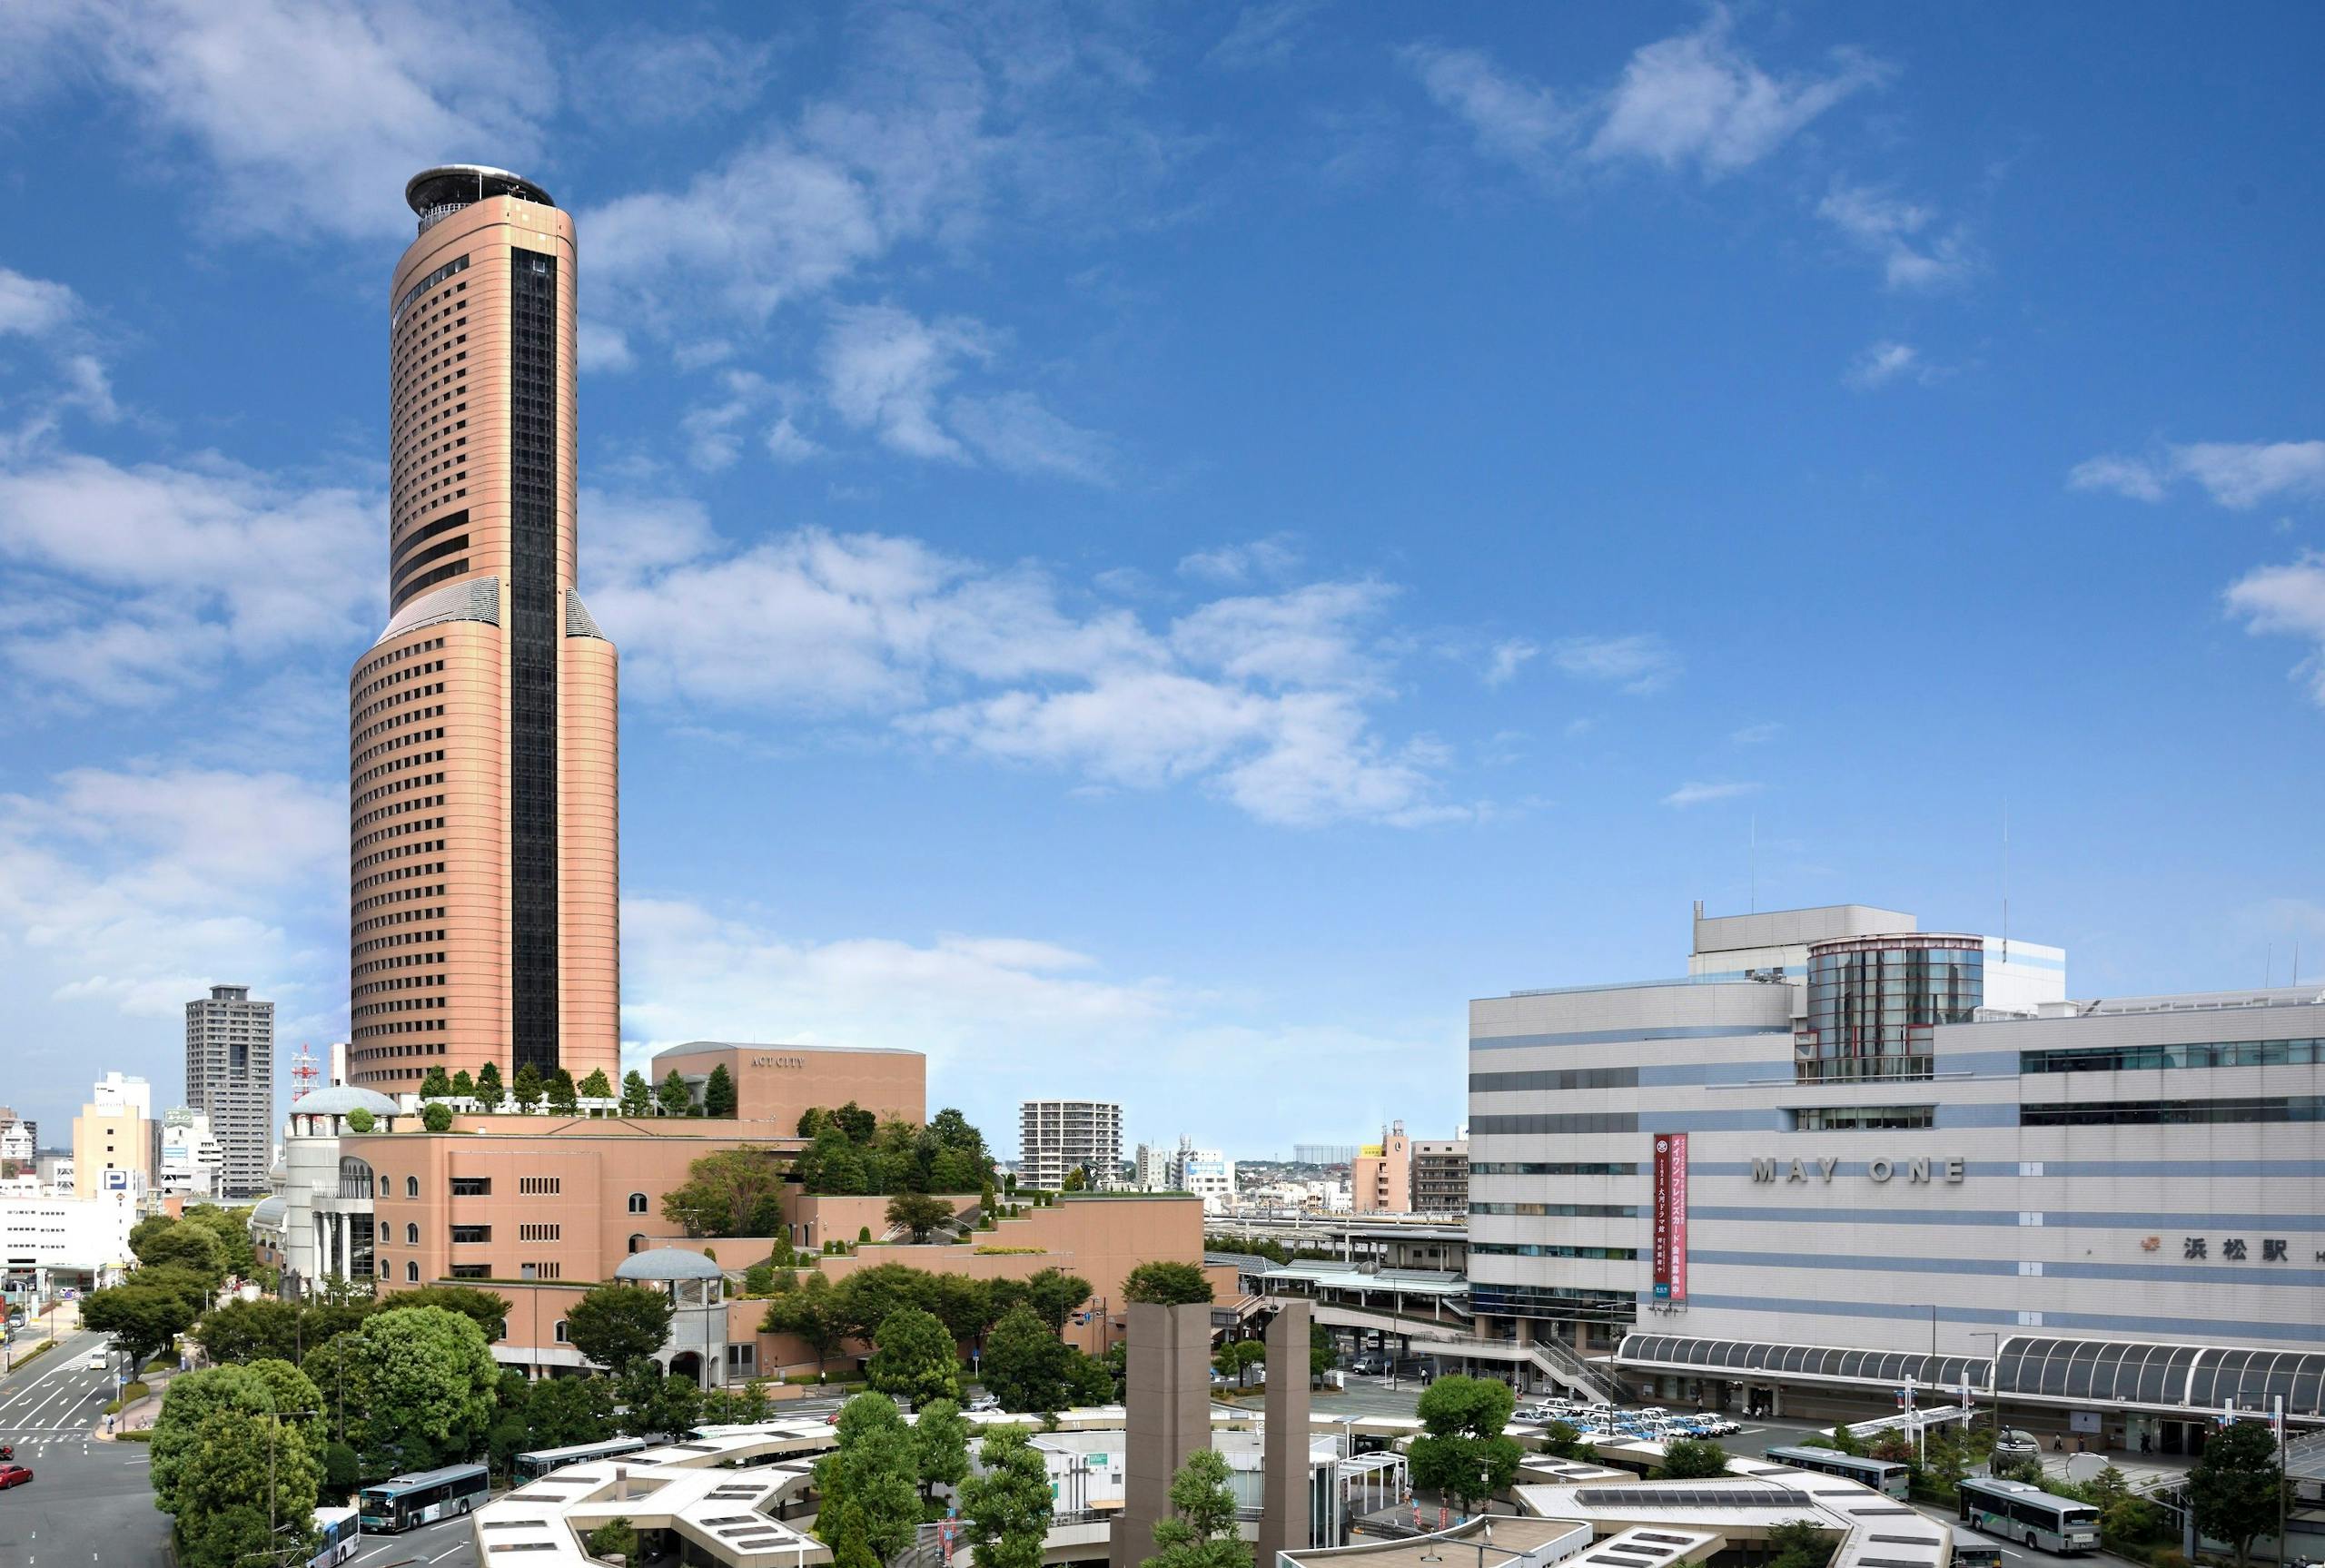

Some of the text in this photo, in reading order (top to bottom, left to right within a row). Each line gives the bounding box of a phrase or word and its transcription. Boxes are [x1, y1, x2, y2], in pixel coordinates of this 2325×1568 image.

[751, 1056, 806, 1069] ACT CITY
[1751, 1157, 1964, 1184] MAY ONE
[105, 1172, 125, 1189] P
[2183, 1237, 2289, 1262] 浜松駅
[1073, 1421, 1081, 1429] 11
[1255, 1421, 1264, 1429] 12
[1396, 1442, 1403, 1451] 13
